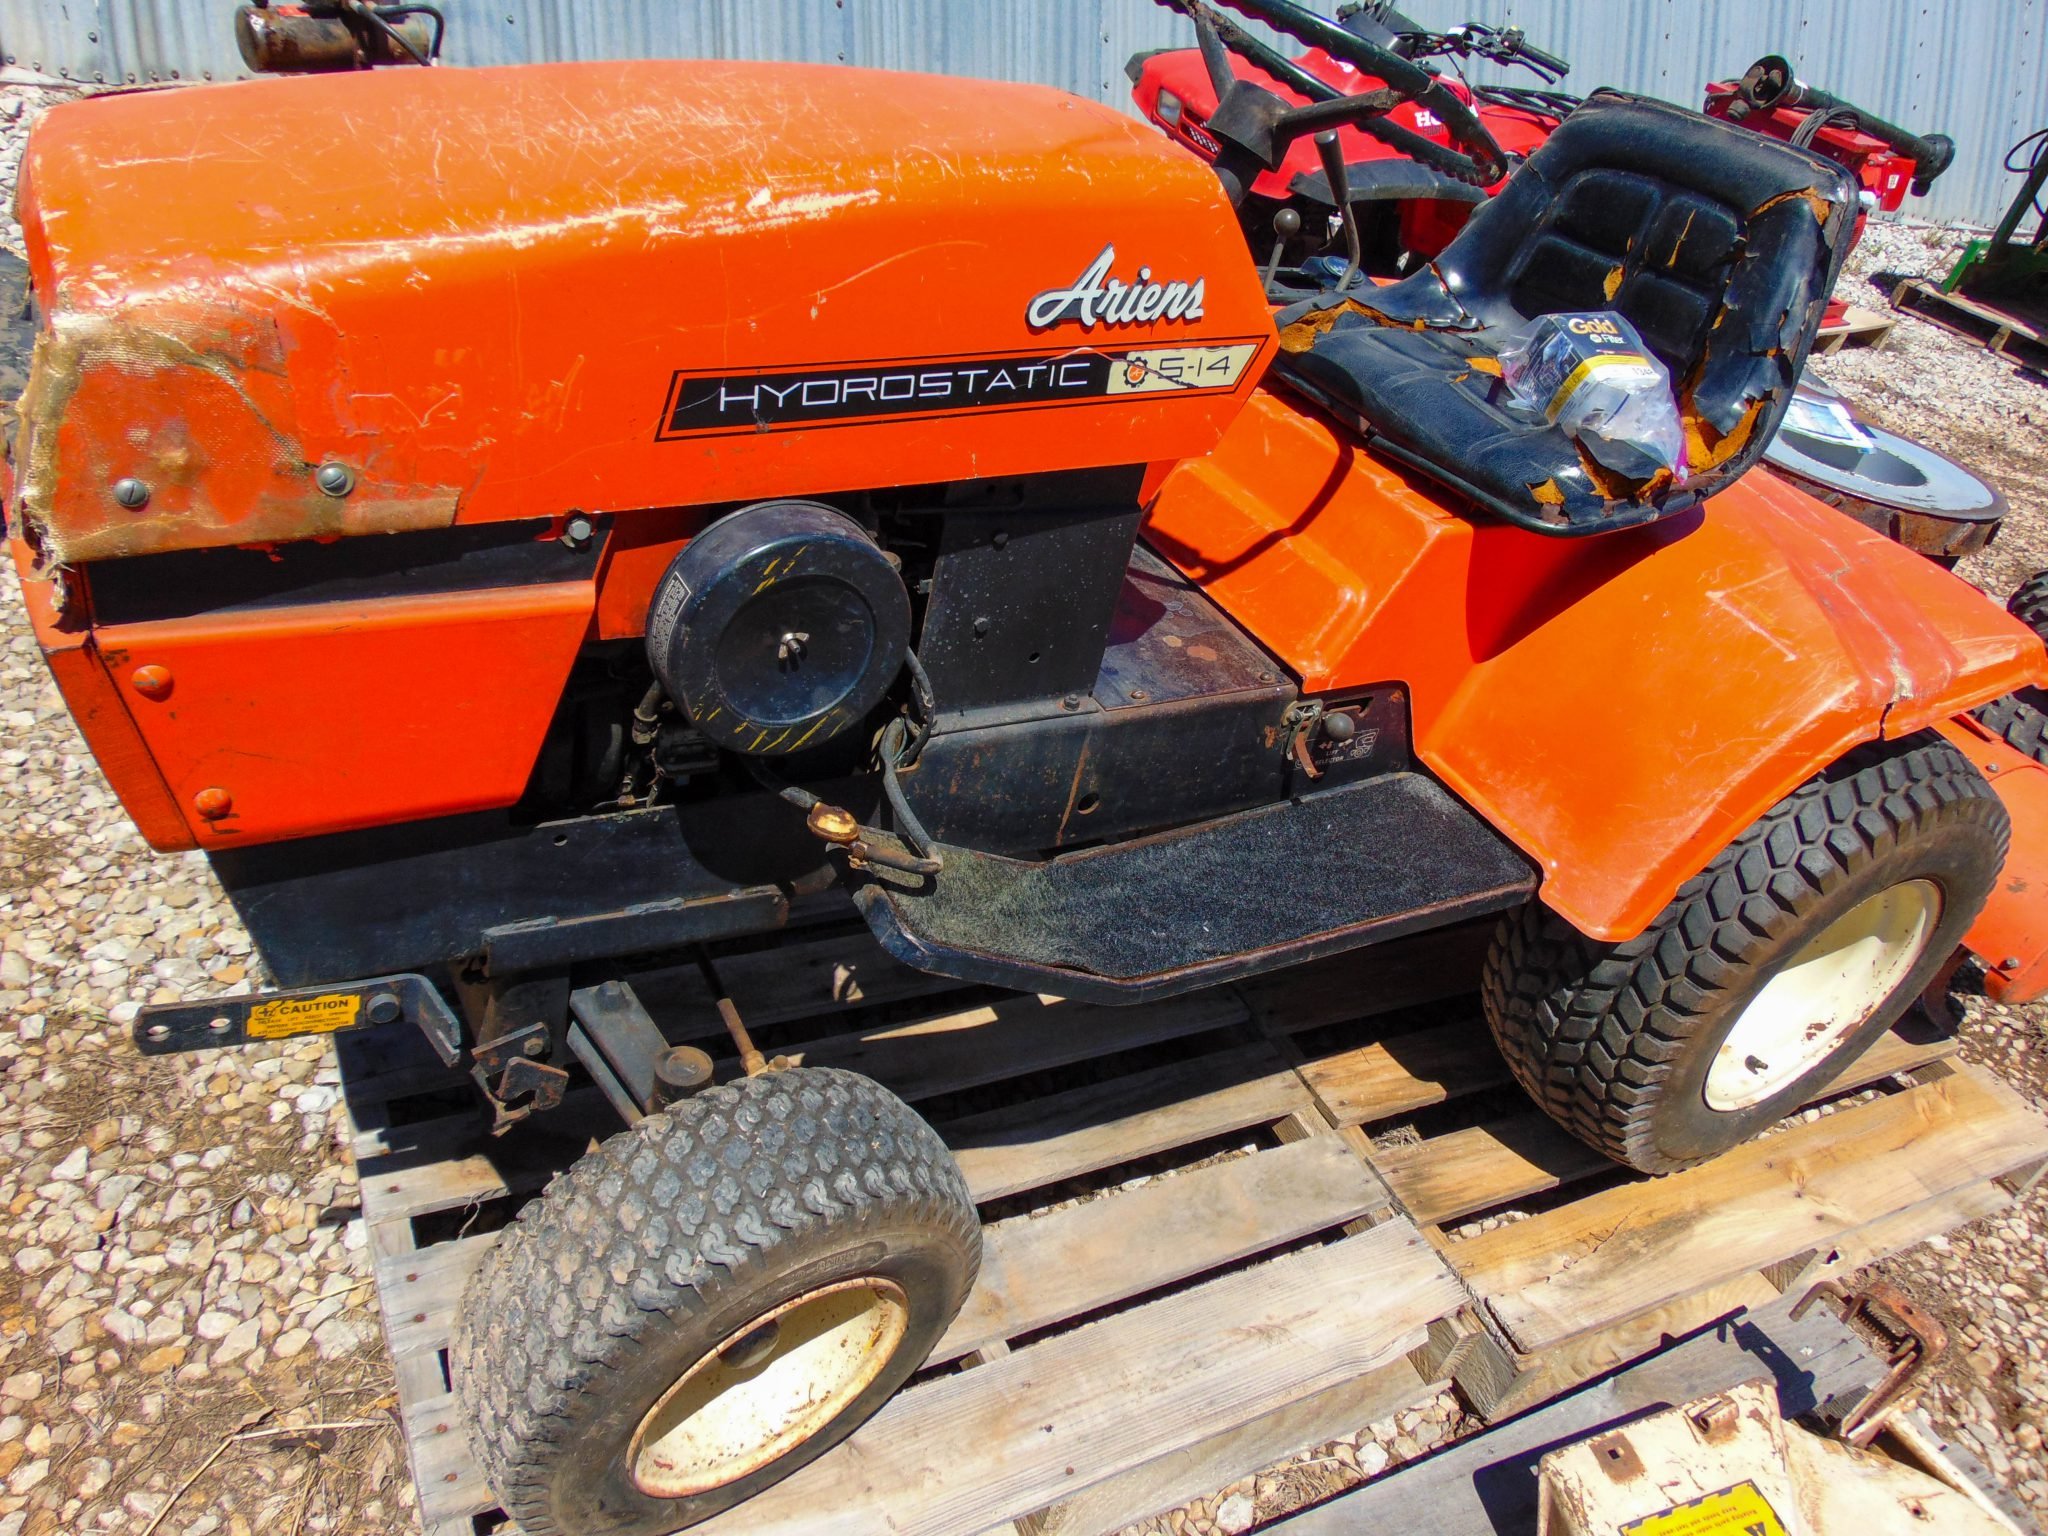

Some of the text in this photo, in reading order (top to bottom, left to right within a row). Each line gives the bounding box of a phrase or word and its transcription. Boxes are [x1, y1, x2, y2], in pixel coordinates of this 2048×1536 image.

[1026, 243, 1204, 330] Ariens
[1568, 318, 1619, 334] Gold
[720, 363, 1090, 411] HYDROSTATIC
[280, 999, 349, 1015] CAUTION
